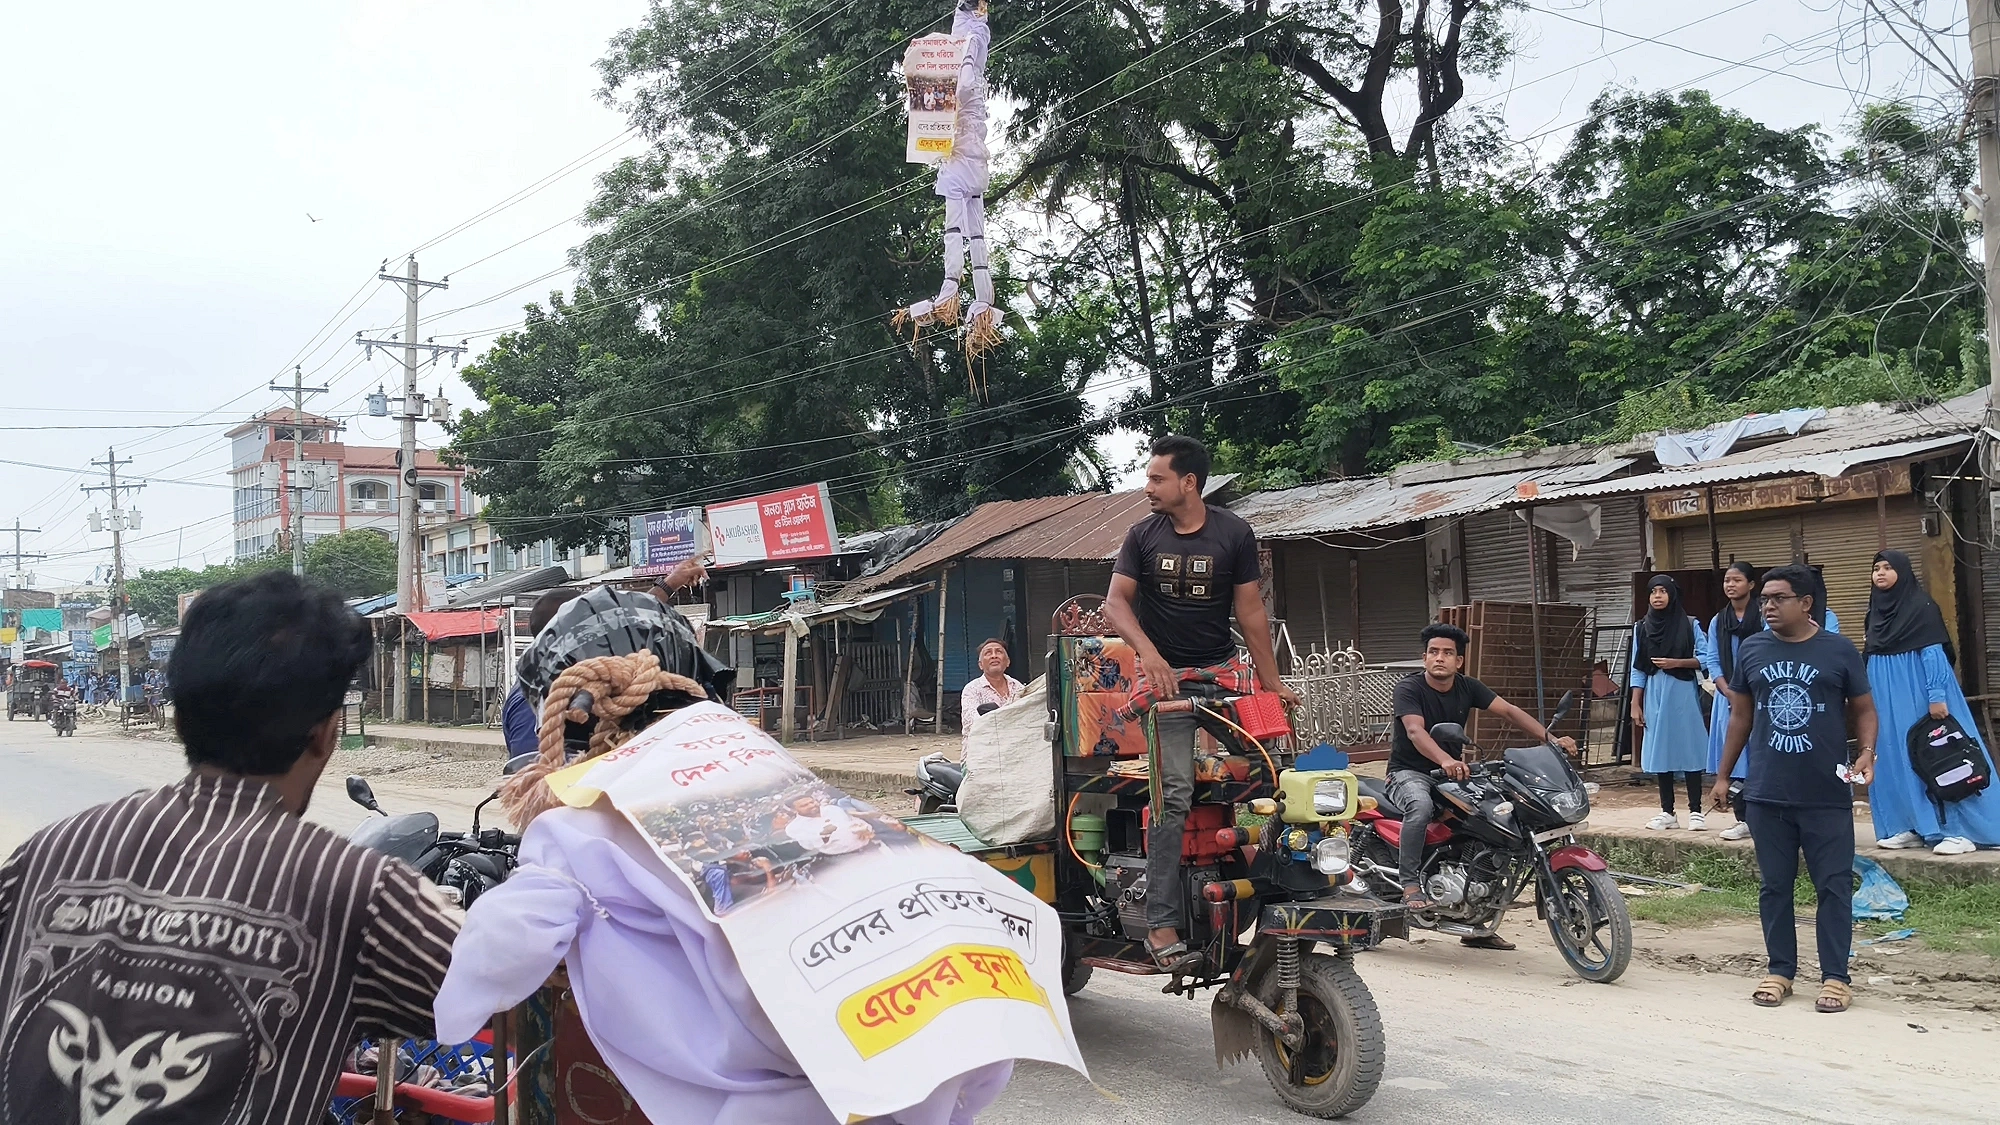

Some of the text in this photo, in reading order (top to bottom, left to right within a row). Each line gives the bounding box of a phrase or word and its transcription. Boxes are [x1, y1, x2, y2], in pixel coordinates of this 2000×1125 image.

[762, 501, 783, 517] জনতা
[1760, 661, 1819, 685] TAKE ME
[1768, 730, 1813, 753] SHORE
[671, 760, 730, 787] দেশ
[802, 908, 895, 968] এদের
[898, 882, 994, 920] প্রতিহত
[91, 969, 196, 1010] FASHION
[856, 951, 1023, 1029] এদের ঘৃনা
